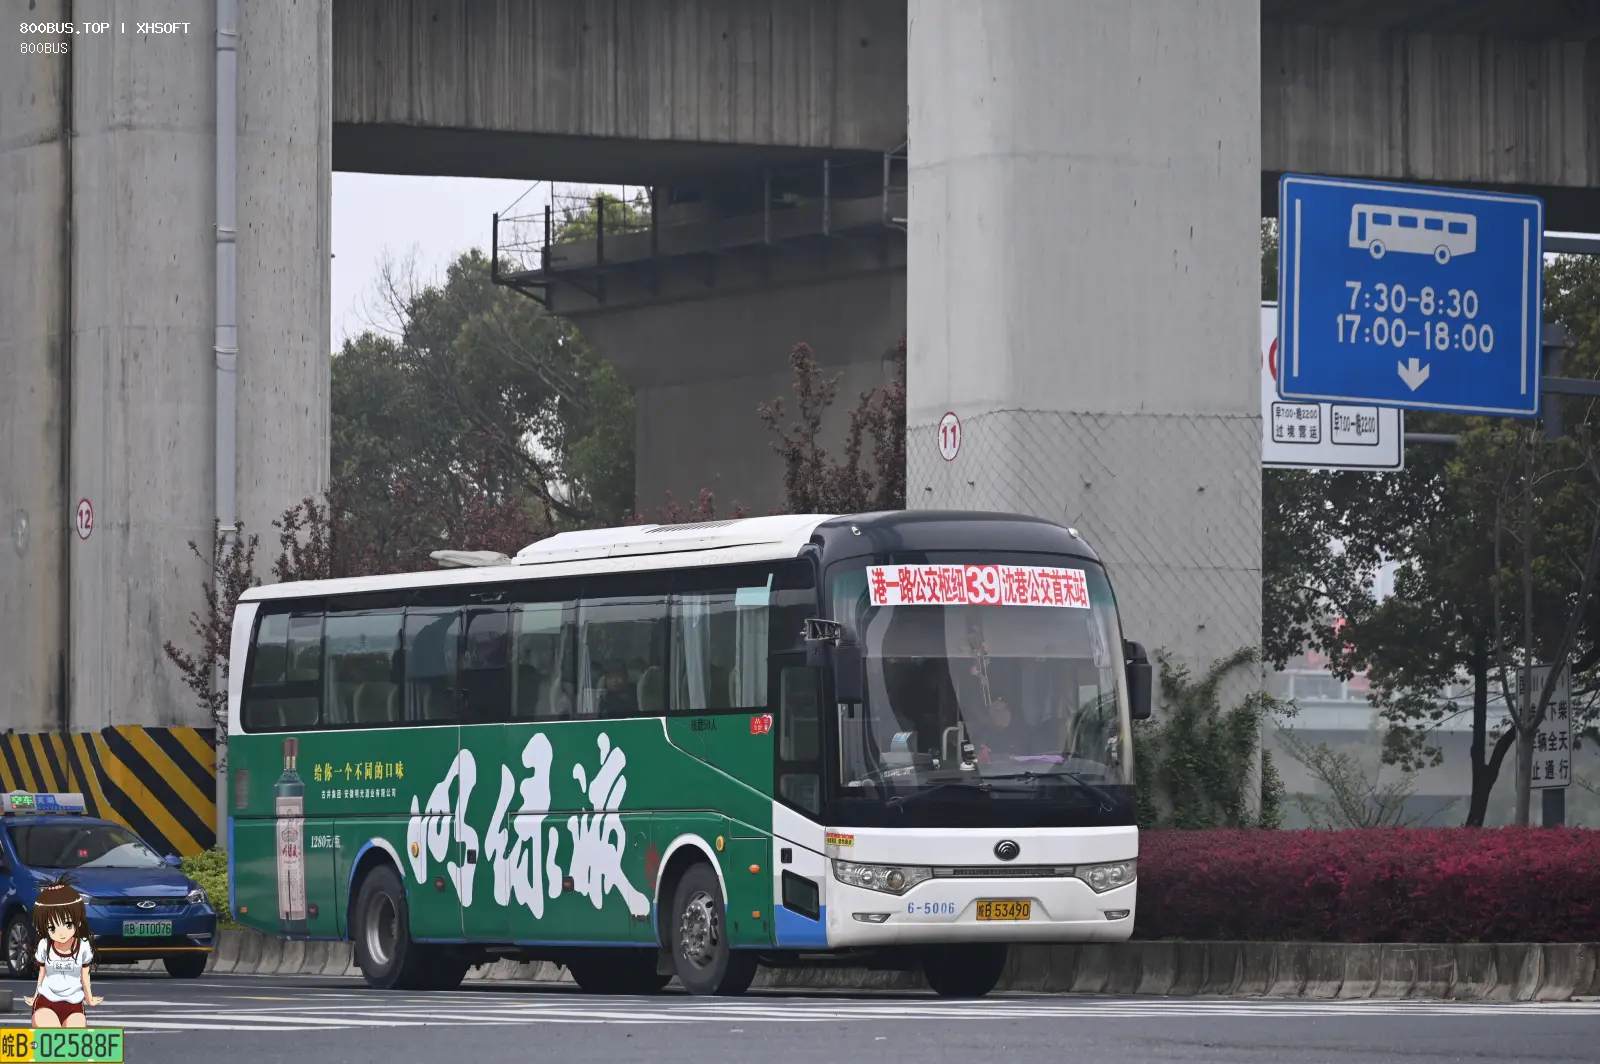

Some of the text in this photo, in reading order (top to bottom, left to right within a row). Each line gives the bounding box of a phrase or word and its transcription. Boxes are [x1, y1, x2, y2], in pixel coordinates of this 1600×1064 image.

[1345, 280, 1479, 319] 7:30-8:30
[1336, 313, 1494, 353] 17:00-18:00
[941, 424, 957, 449] 11
[1275, 424, 1318, 439] 过境营运
[78, 509, 91, 529] 12
[870, 566, 1088, 607] 港一路公交枢纽 39 沈巷公交首末站
[313, 760, 404, 782] 给你一个不同的口味
[907, 901, 956, 915] 6-5006
